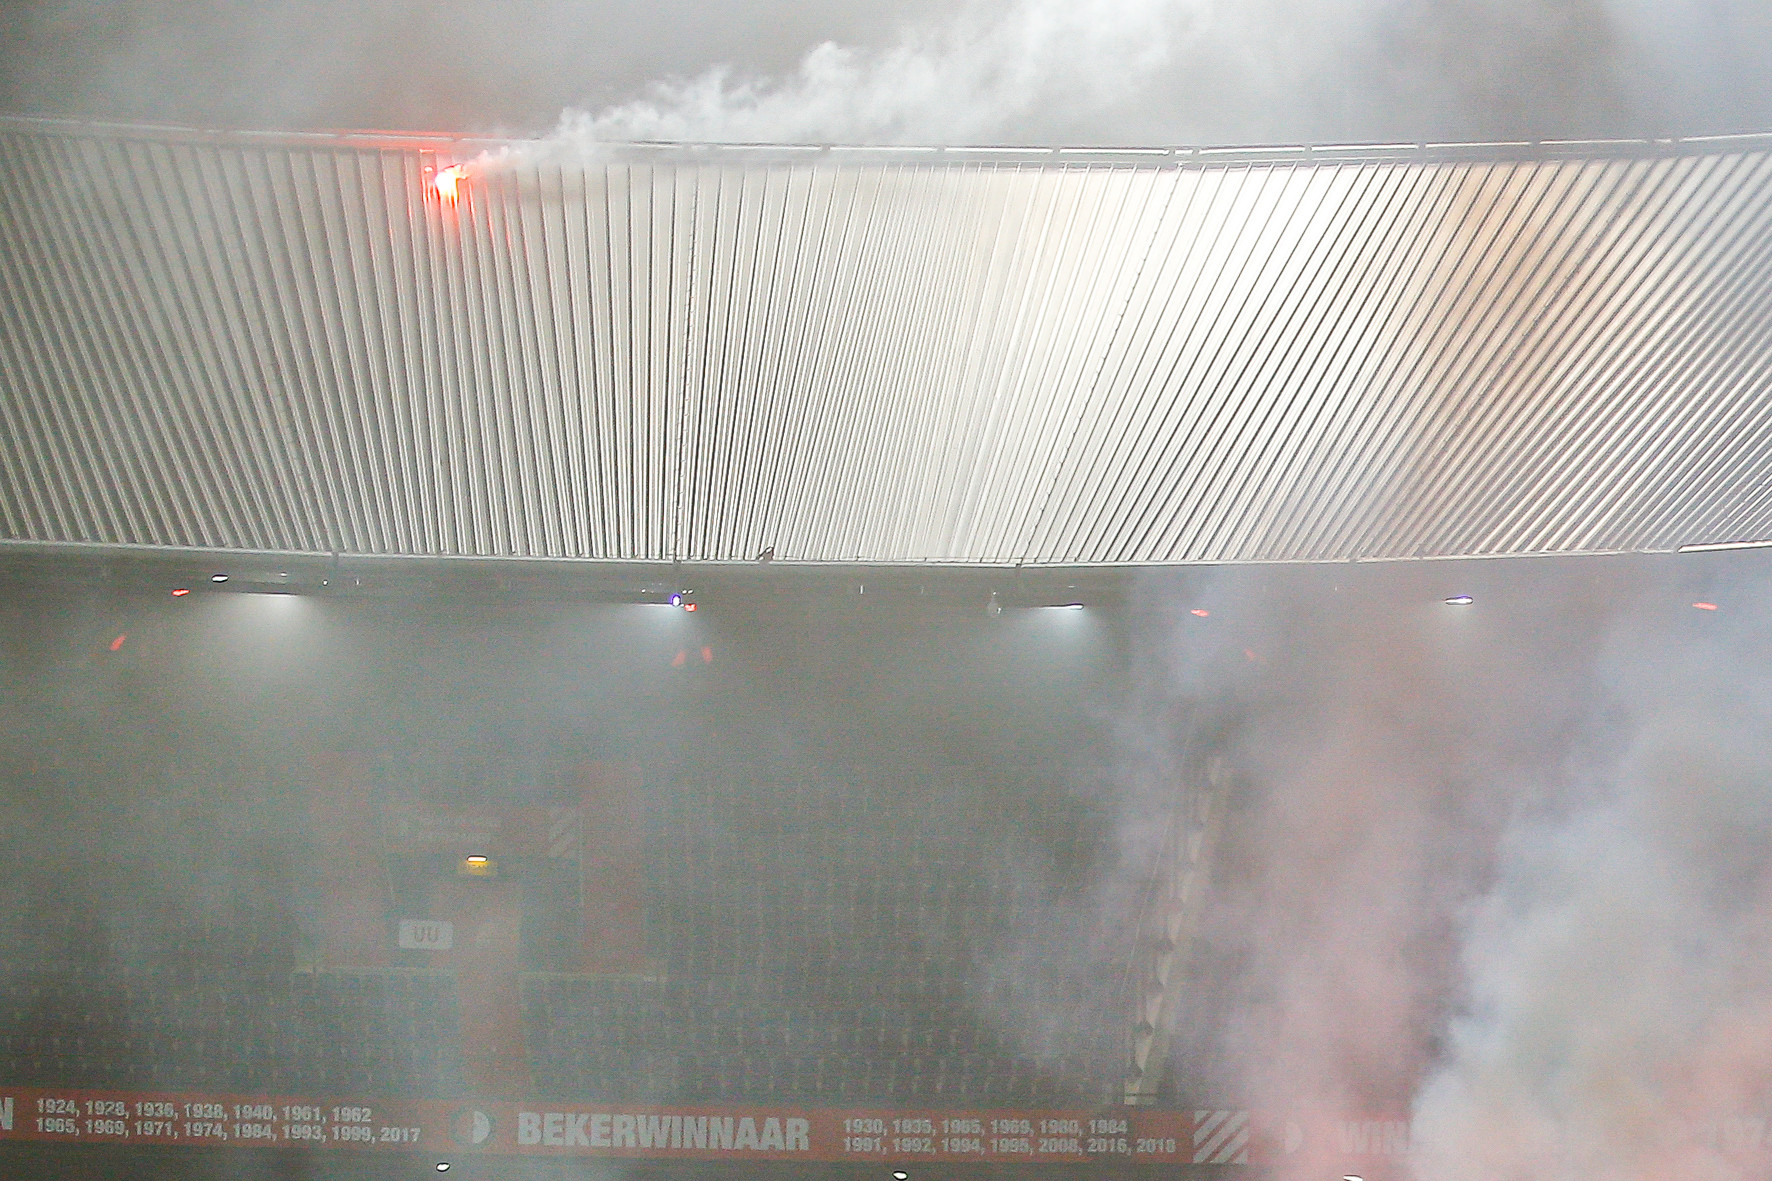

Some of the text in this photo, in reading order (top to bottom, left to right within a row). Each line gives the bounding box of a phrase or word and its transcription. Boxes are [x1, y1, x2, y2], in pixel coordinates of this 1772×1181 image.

[37, 1098, 80, 1118] 1924,
[134, 1120, 179, 1139] 1971,
[183, 1121, 228, 1140] 1974,
[380, 1126, 421, 1144] 2017
[517, 1111, 810, 1152] BEKERWINNAAR
[843, 1118, 887, 1136] 1930,
[892, 1137, 936, 1155] 1992,
